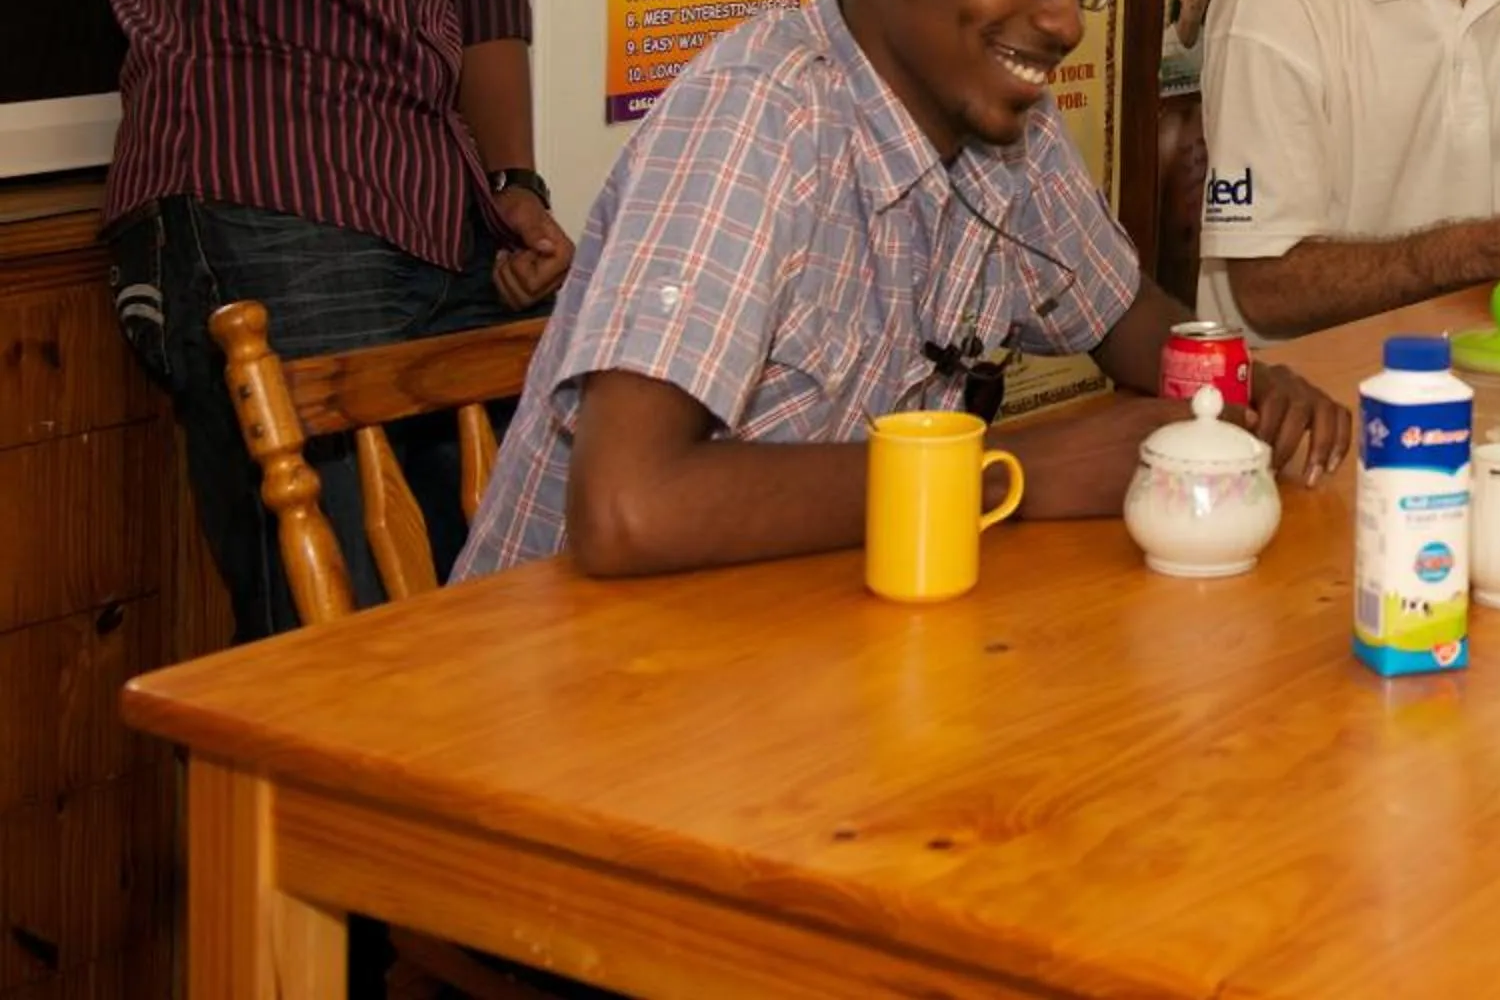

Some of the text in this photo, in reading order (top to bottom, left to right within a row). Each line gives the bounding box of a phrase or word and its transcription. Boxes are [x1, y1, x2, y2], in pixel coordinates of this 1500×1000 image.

[643, 9, 676, 25] MEET
[680, 1, 758, 22] INTERESTING
[643, 37, 673, 53] EASY
[680, 33, 705, 49] WAY
[1060, 63, 1095, 84] YOUR
[1056, 91, 1088, 112] FOR:
